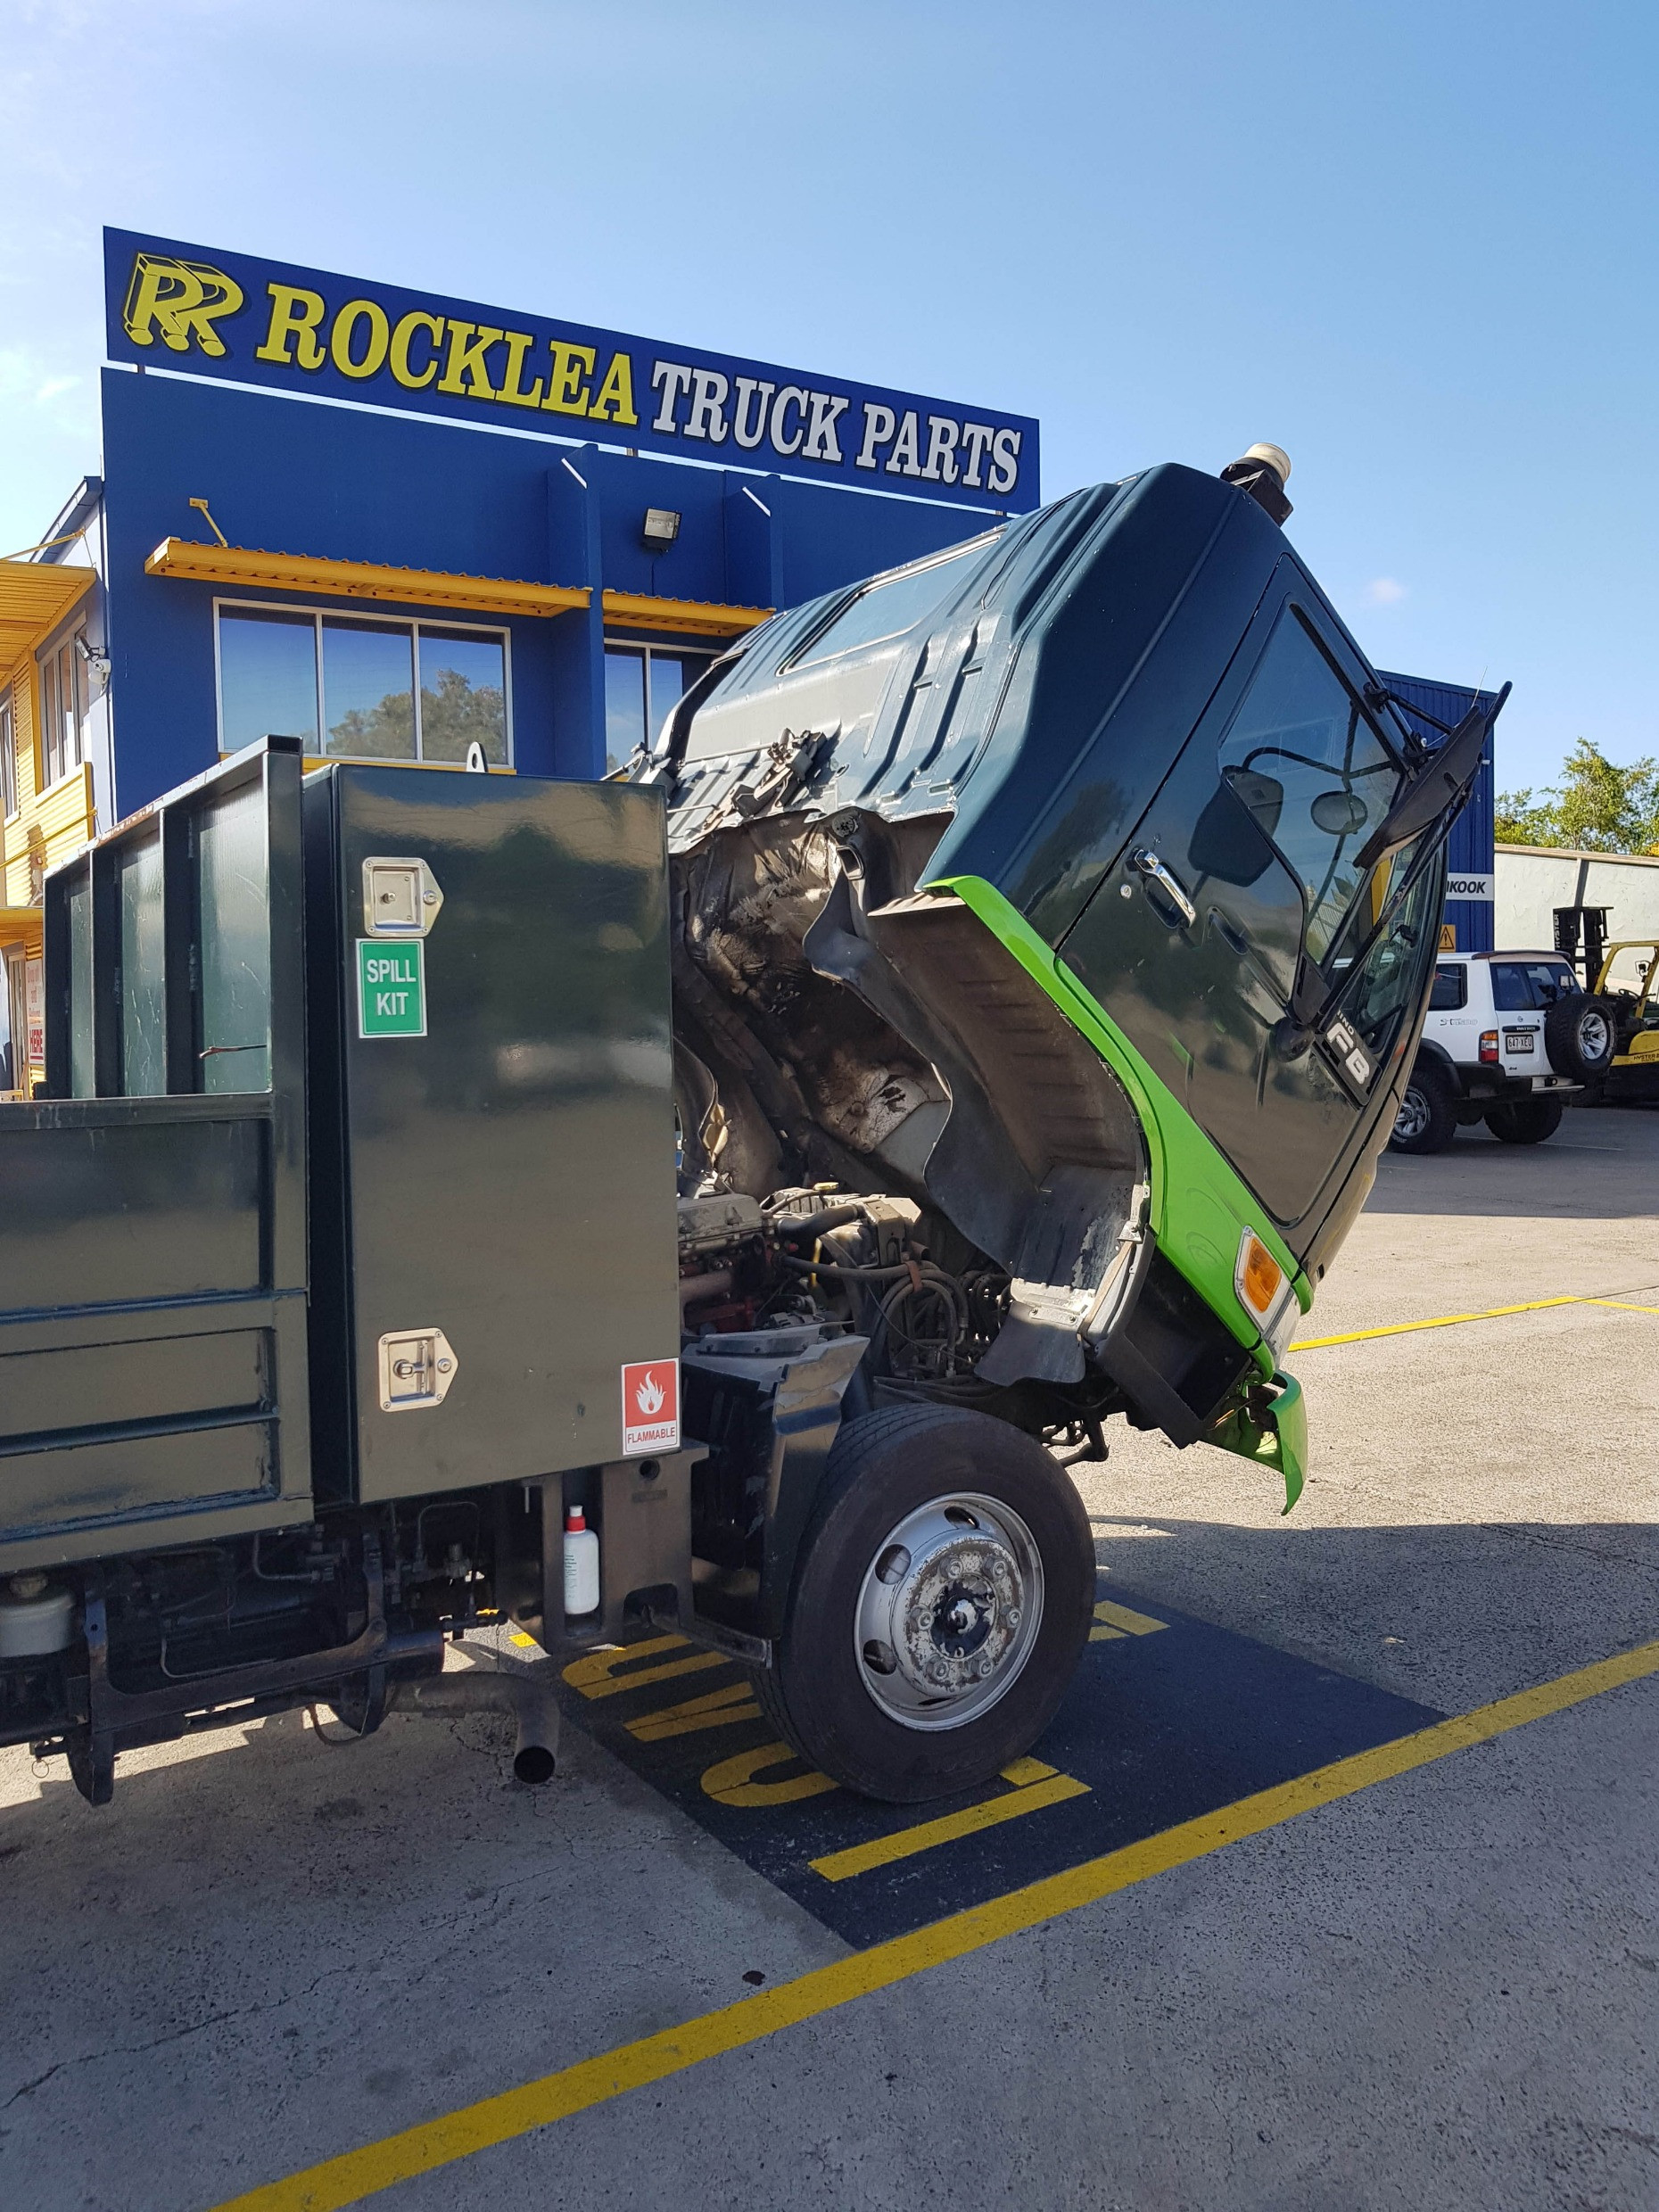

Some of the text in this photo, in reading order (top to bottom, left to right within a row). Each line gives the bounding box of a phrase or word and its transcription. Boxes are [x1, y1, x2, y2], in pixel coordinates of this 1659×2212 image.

[256, 284, 639, 426] ROCKLEA
[652, 361, 849, 463] TRUCK
[856, 403, 1023, 494] PARTS
[367, 959, 417, 984] SPILL
[376, 992, 409, 1016] KIT
[29, 1028, 44, 1053] HERE
[1326, 1022, 1370, 1085] FB
[627, 1427, 676, 1444] FLAMMABLE
